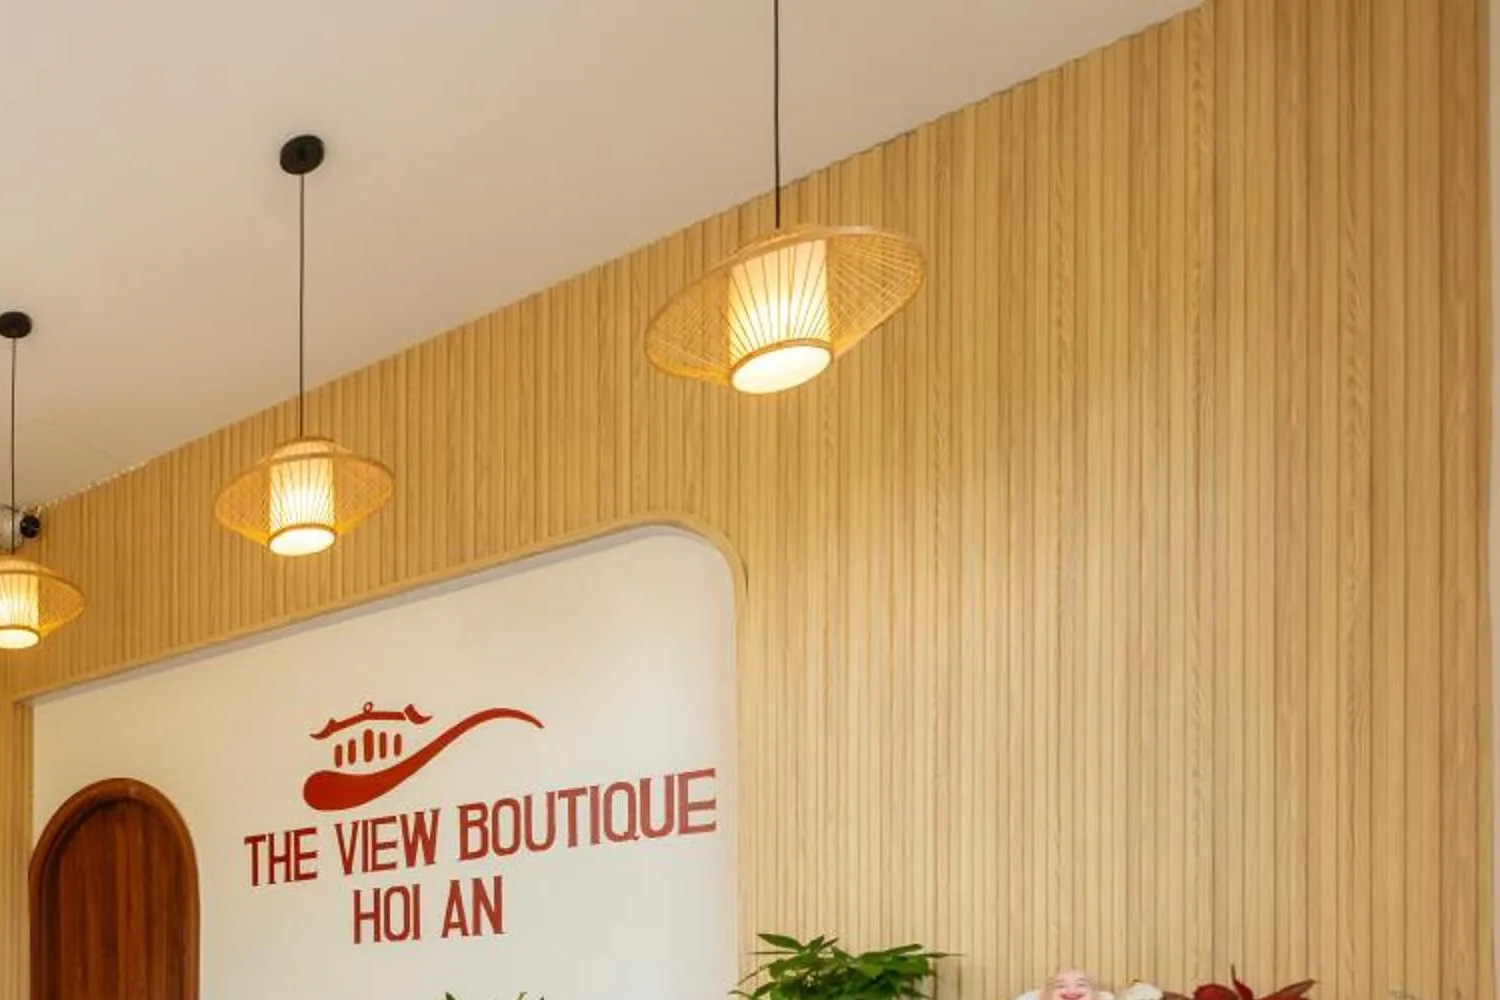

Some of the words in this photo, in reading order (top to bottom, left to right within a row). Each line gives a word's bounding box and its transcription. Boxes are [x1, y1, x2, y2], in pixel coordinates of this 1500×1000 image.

[243, 827, 319, 888] THE
[335, 809, 440, 878] VIEW
[457, 767, 716, 861] BOUTIQUE
[353, 885, 421, 944] HOI
[442, 873, 504, 937] AN
